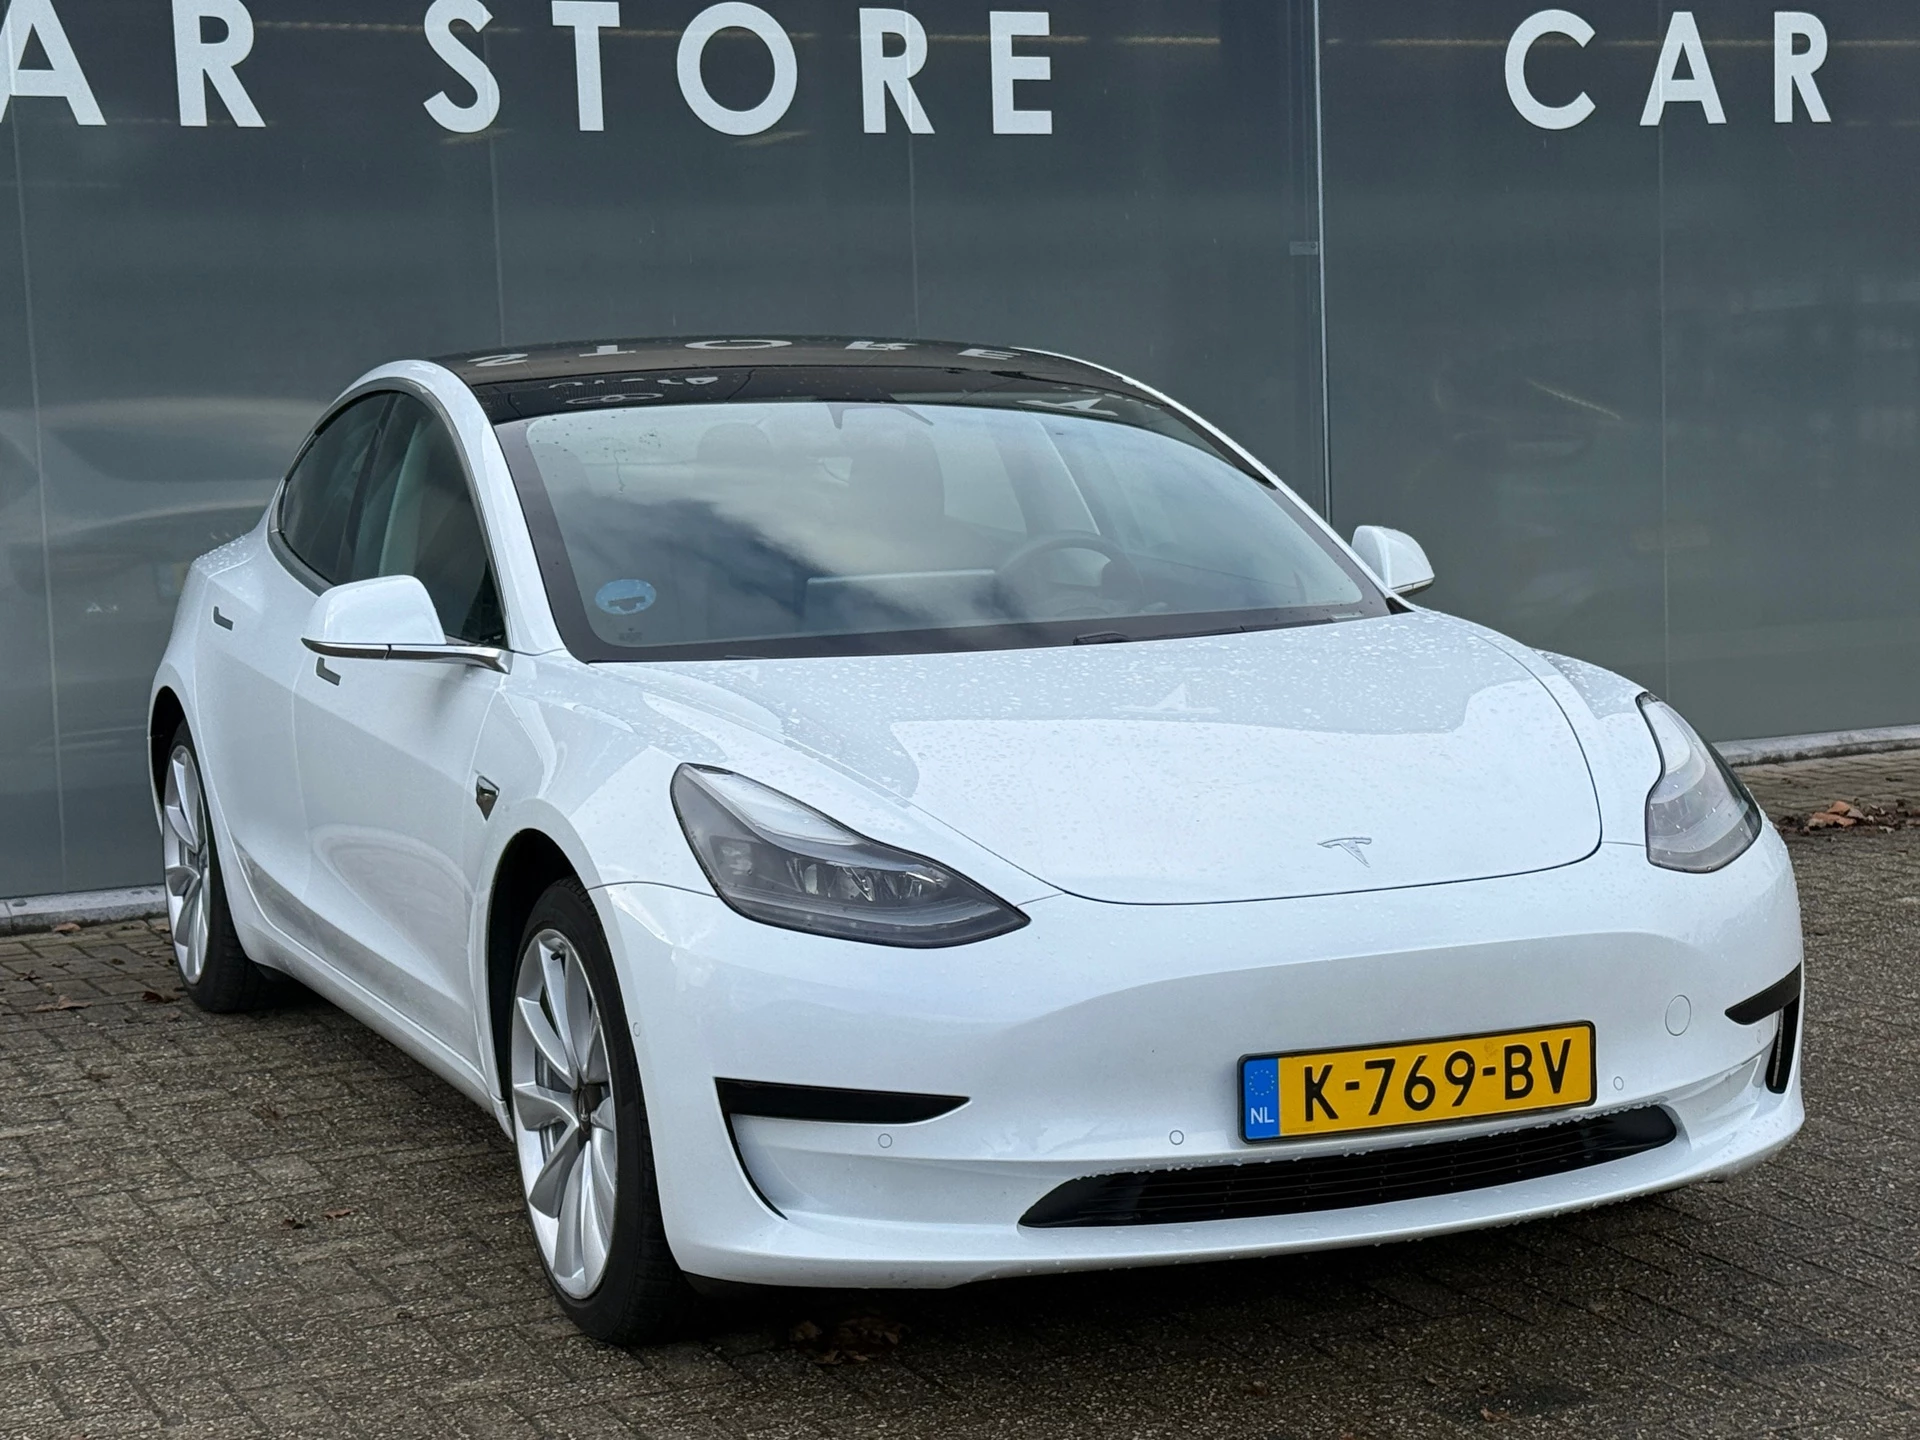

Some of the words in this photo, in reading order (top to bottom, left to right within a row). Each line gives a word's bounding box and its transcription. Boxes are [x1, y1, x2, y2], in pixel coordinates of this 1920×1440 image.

[423, 0, 1053, 135] STORE
[1504, 9, 1832, 130] CAR
[1250, 1107, 1275, 1125] NL
[1304, 1037, 1573, 1122] K-769-BV
